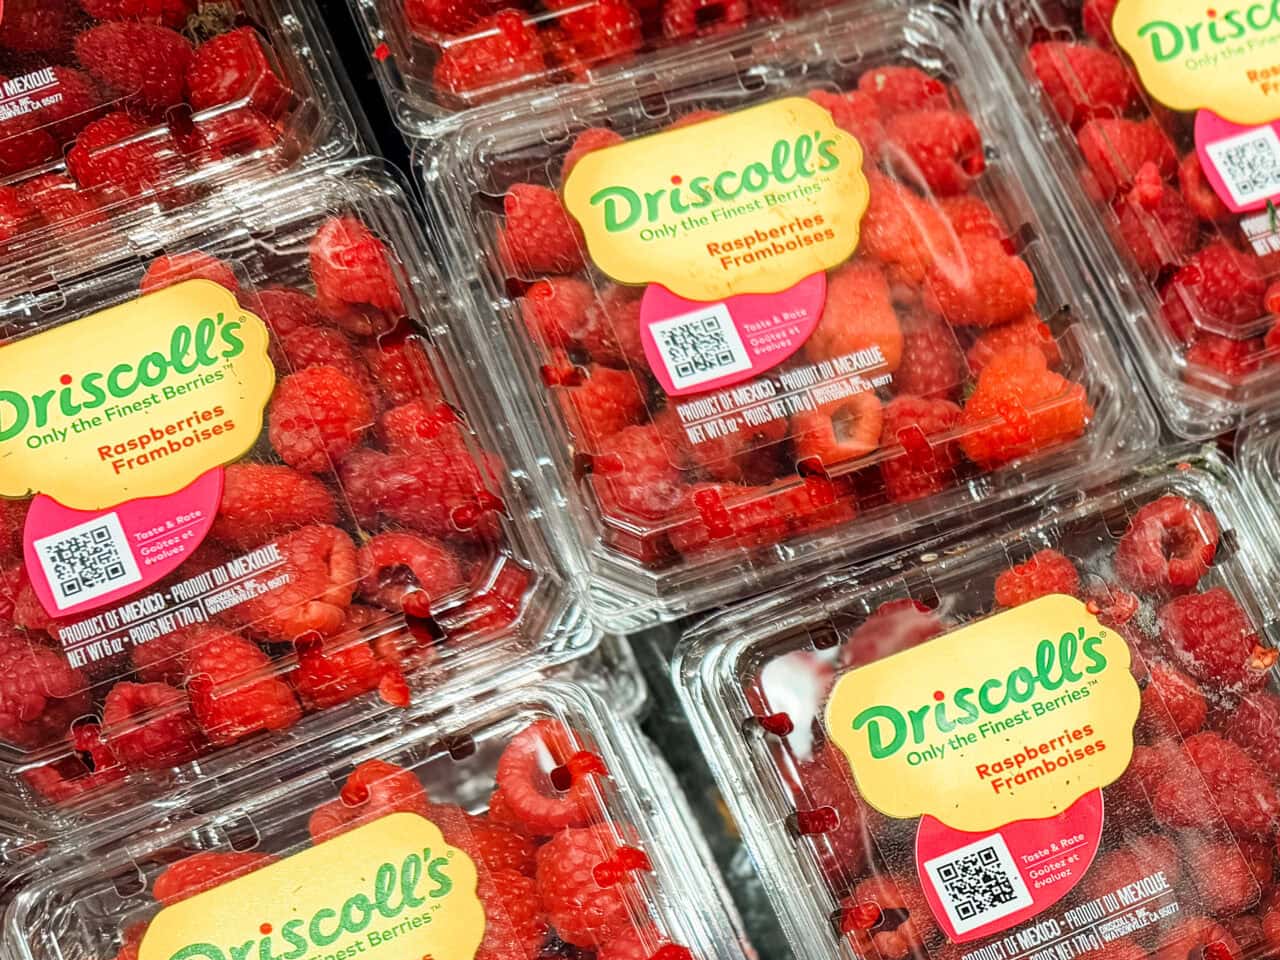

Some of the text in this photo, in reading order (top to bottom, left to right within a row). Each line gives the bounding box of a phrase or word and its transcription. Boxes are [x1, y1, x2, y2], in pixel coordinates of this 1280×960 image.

[3, 66, 58, 97] MEXIQUE
[639, 222, 676, 242] Only
[679, 214, 709, 230] the
[711, 197, 763, 221] Finest
[706, 214, 824, 256] Raspberries
[720, 228, 834, 270] Framboises
[27, 426, 66, 450] Only
[70, 416, 102, 434] the
[104, 391, 160, 422] Finest
[98, 405, 224, 460] Raspberries
[112, 419, 235, 475] Framboises
[58, 543, 283, 648] PRODUCT OF MEXICO PRODUIT DU MEXIQUE
[907, 742, 943, 768] Only
[946, 732, 977, 751] the
[978, 708, 1031, 739] Finest
[976, 723, 1094, 779] Raspberries
[991, 739, 1106, 795] Framboises
[1020, 834, 1085, 864] Taste & Rate
[1068, 853, 1080, 864] et
[1002, 935, 1020, 956] OF
[1015, 917, 1062, 951] MEXICO
[1063, 897, 1107, 929] PRODUIT
[1102, 892, 1120, 913] DU
[1116, 870, 1170, 907] MEXIQUE
